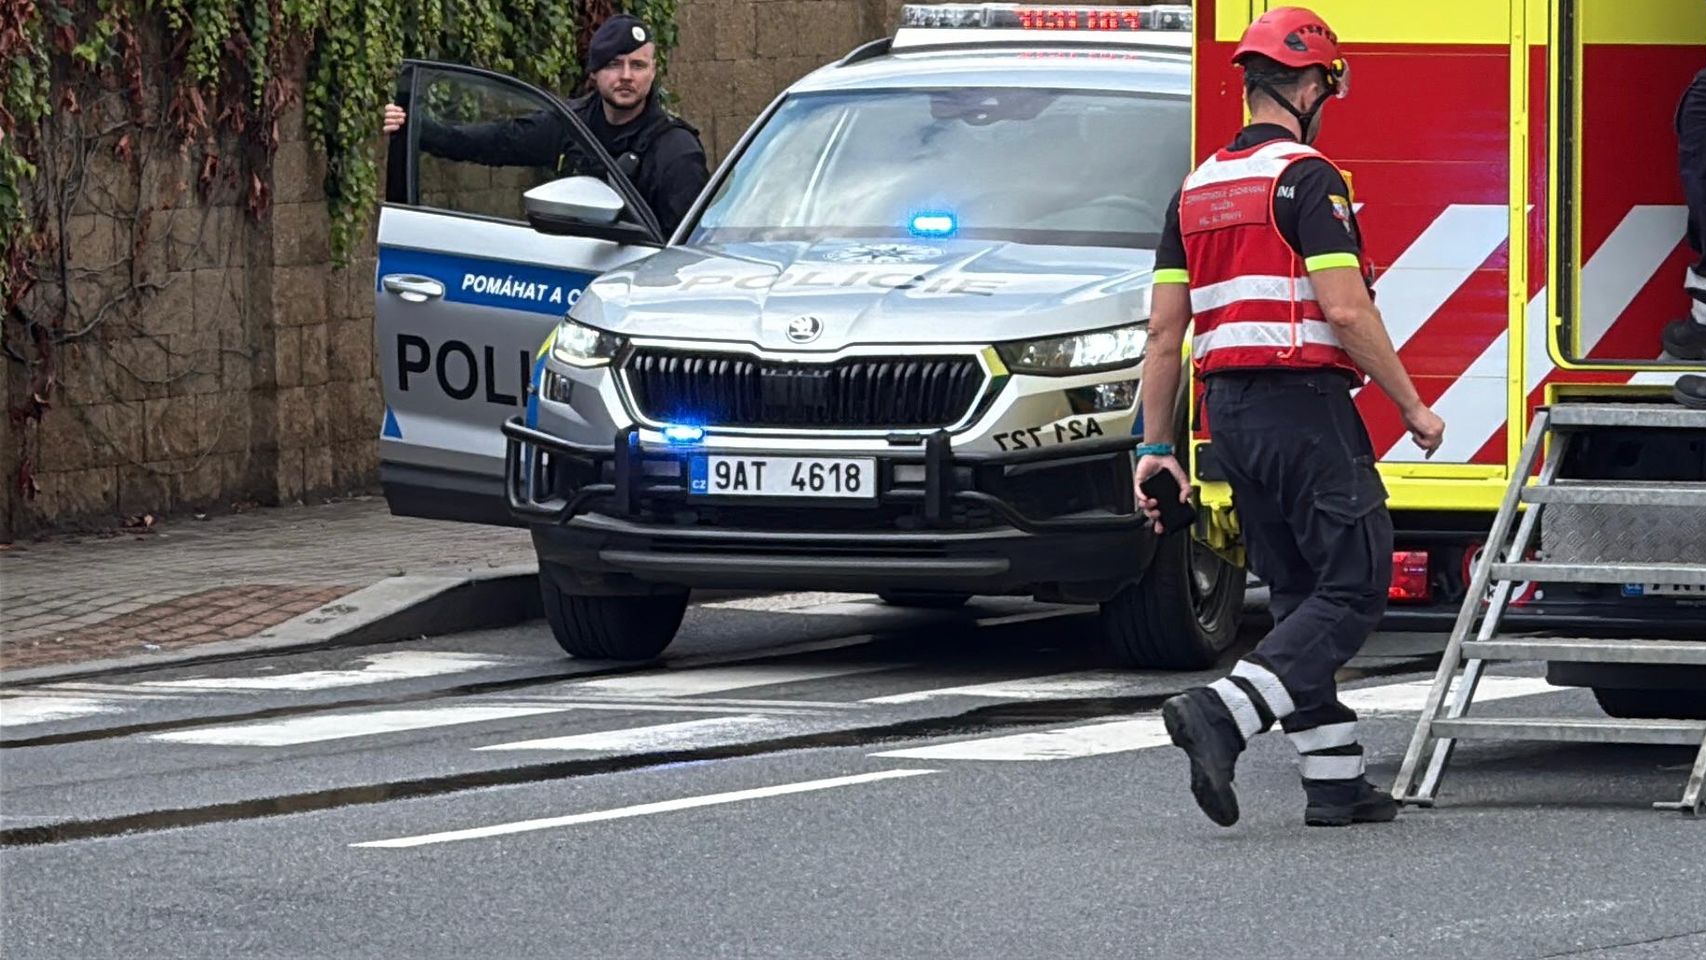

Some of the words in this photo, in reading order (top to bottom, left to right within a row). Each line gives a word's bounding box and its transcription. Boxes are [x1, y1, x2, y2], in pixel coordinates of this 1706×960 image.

[462, 274, 548, 301] POMÁHAT
[549, 290, 562, 305] A
[678, 271, 1008, 297] POLICIE
[692, 480, 707, 489] CZ
[715, 461, 766, 491] 9AT
[791, 462, 861, 493] 4618
